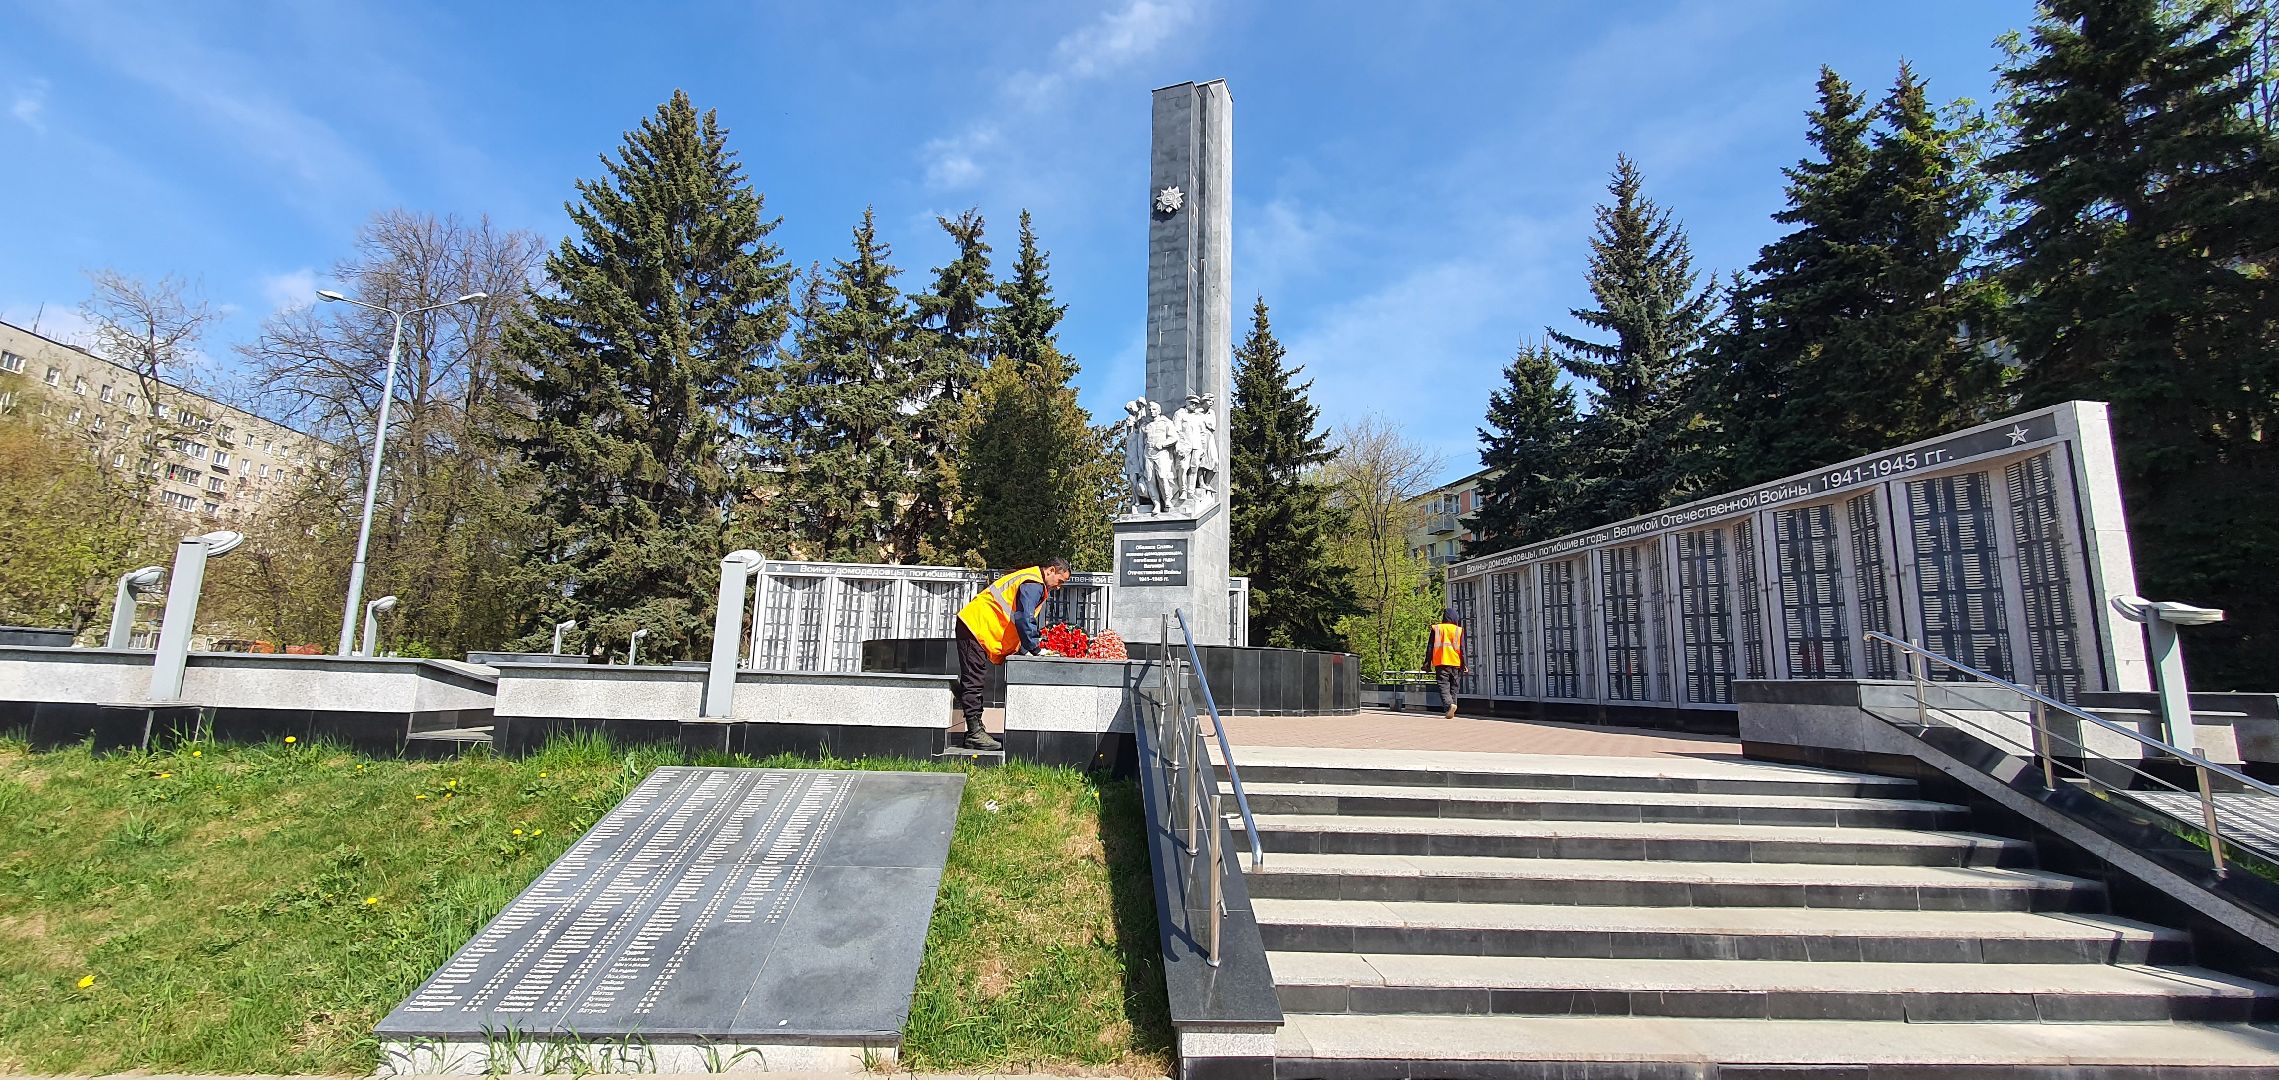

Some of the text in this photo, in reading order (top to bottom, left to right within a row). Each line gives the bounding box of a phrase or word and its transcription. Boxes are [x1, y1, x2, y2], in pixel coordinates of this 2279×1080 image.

[1539, 540, 1579, 557] погибшие
[1586, 532, 1609, 545] годы
[1613, 518, 1658, 539] Великой
[1660, 493, 1758, 527] Отечественной
[1759, 481, 1812, 504] Войны
[1820, 452, 1918, 490] 1941-1945
[1924, 448, 1954, 466] гг.
[800, 564, 908, 578] Воины-домодедовцы,
[909, 569, 957, 579] погибшие
[964, 571, 989, 580] годы
